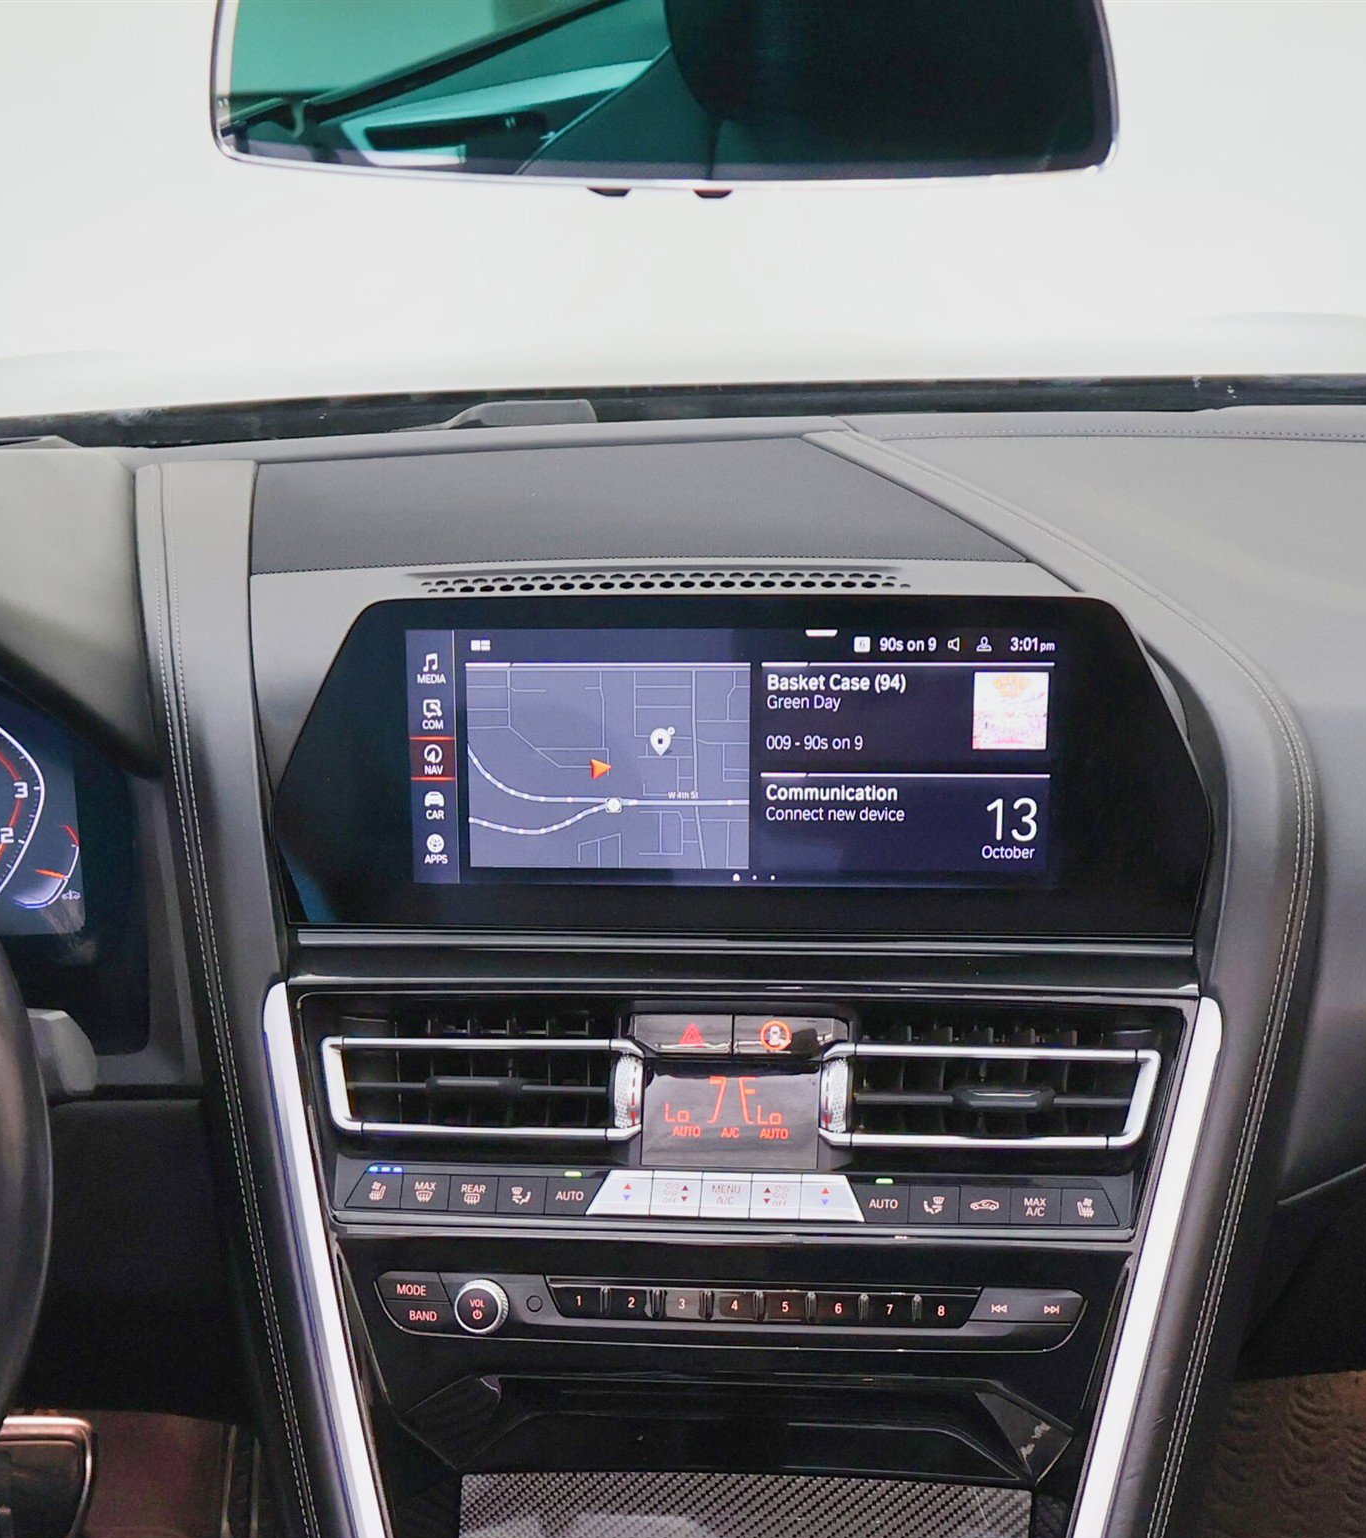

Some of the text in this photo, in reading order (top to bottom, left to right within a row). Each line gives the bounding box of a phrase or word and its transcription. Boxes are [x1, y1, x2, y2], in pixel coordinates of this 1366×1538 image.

[879, 636, 904, 652] 90s
[906, 640, 924, 652] on
[927, 637, 937, 652] 9
[1010, 637, 1055, 653] 3:01 pm
[417, 674, 446, 684] MEDIA
[766, 674, 907, 694] Basket Case (94)
[766, 695, 841, 712] Green Day
[422, 719, 444, 730] COM
[766, 735, 792, 750] 009
[803, 735, 829, 751] 90s
[832, 739, 851, 751] on
[854, 735, 864, 751] 9
[424, 765, 444, 775] NAV
[13, 782, 29, 799] 3
[667, 791, 676, 800] W
[765, 784, 899, 802] Communication
[426, 810, 445, 820] CAR
[765, 806, 905, 823] Connect new device
[986, 797, 1038, 843] 13
[0, 827, 15, 844] 2
[981, 846, 1036, 860] October
[424, 855, 449, 864] APPS
[665, 1103, 691, 1123] Lo
[756, 1105, 783, 1126] Lo
[673, 1126, 701, 1138] AUTO
[721, 1127, 740, 1139] A/C
[759, 1128, 790, 1140] AUTO
[414, 1181, 436, 1192] MAX
[461, 1185, 486, 1195] REAR
[711, 1184, 742, 1194] MENU
[555, 1190, 585, 1202] AUTO
[716, 1196, 735, 1206] A/C
[1023, 1197, 1047, 1207] MAX
[868, 1198, 899, 1210] AUTO
[1025, 1207, 1045, 1217] A/C
[396, 1284, 427, 1296] MODE
[469, 1299, 485, 1308] VOL
[575, 1295, 582, 1306] 1
[628, 1297, 636, 1308] 2
[678, 1298, 686, 1310] 3
[731, 1300, 739, 1311] 4
[781, 1301, 789, 1313] 5
[834, 1302, 843, 1314] 6
[886, 1304, 894, 1315] 7
[937, 1305, 945, 1317] 8
[408, 1310, 437, 1322] BAND
